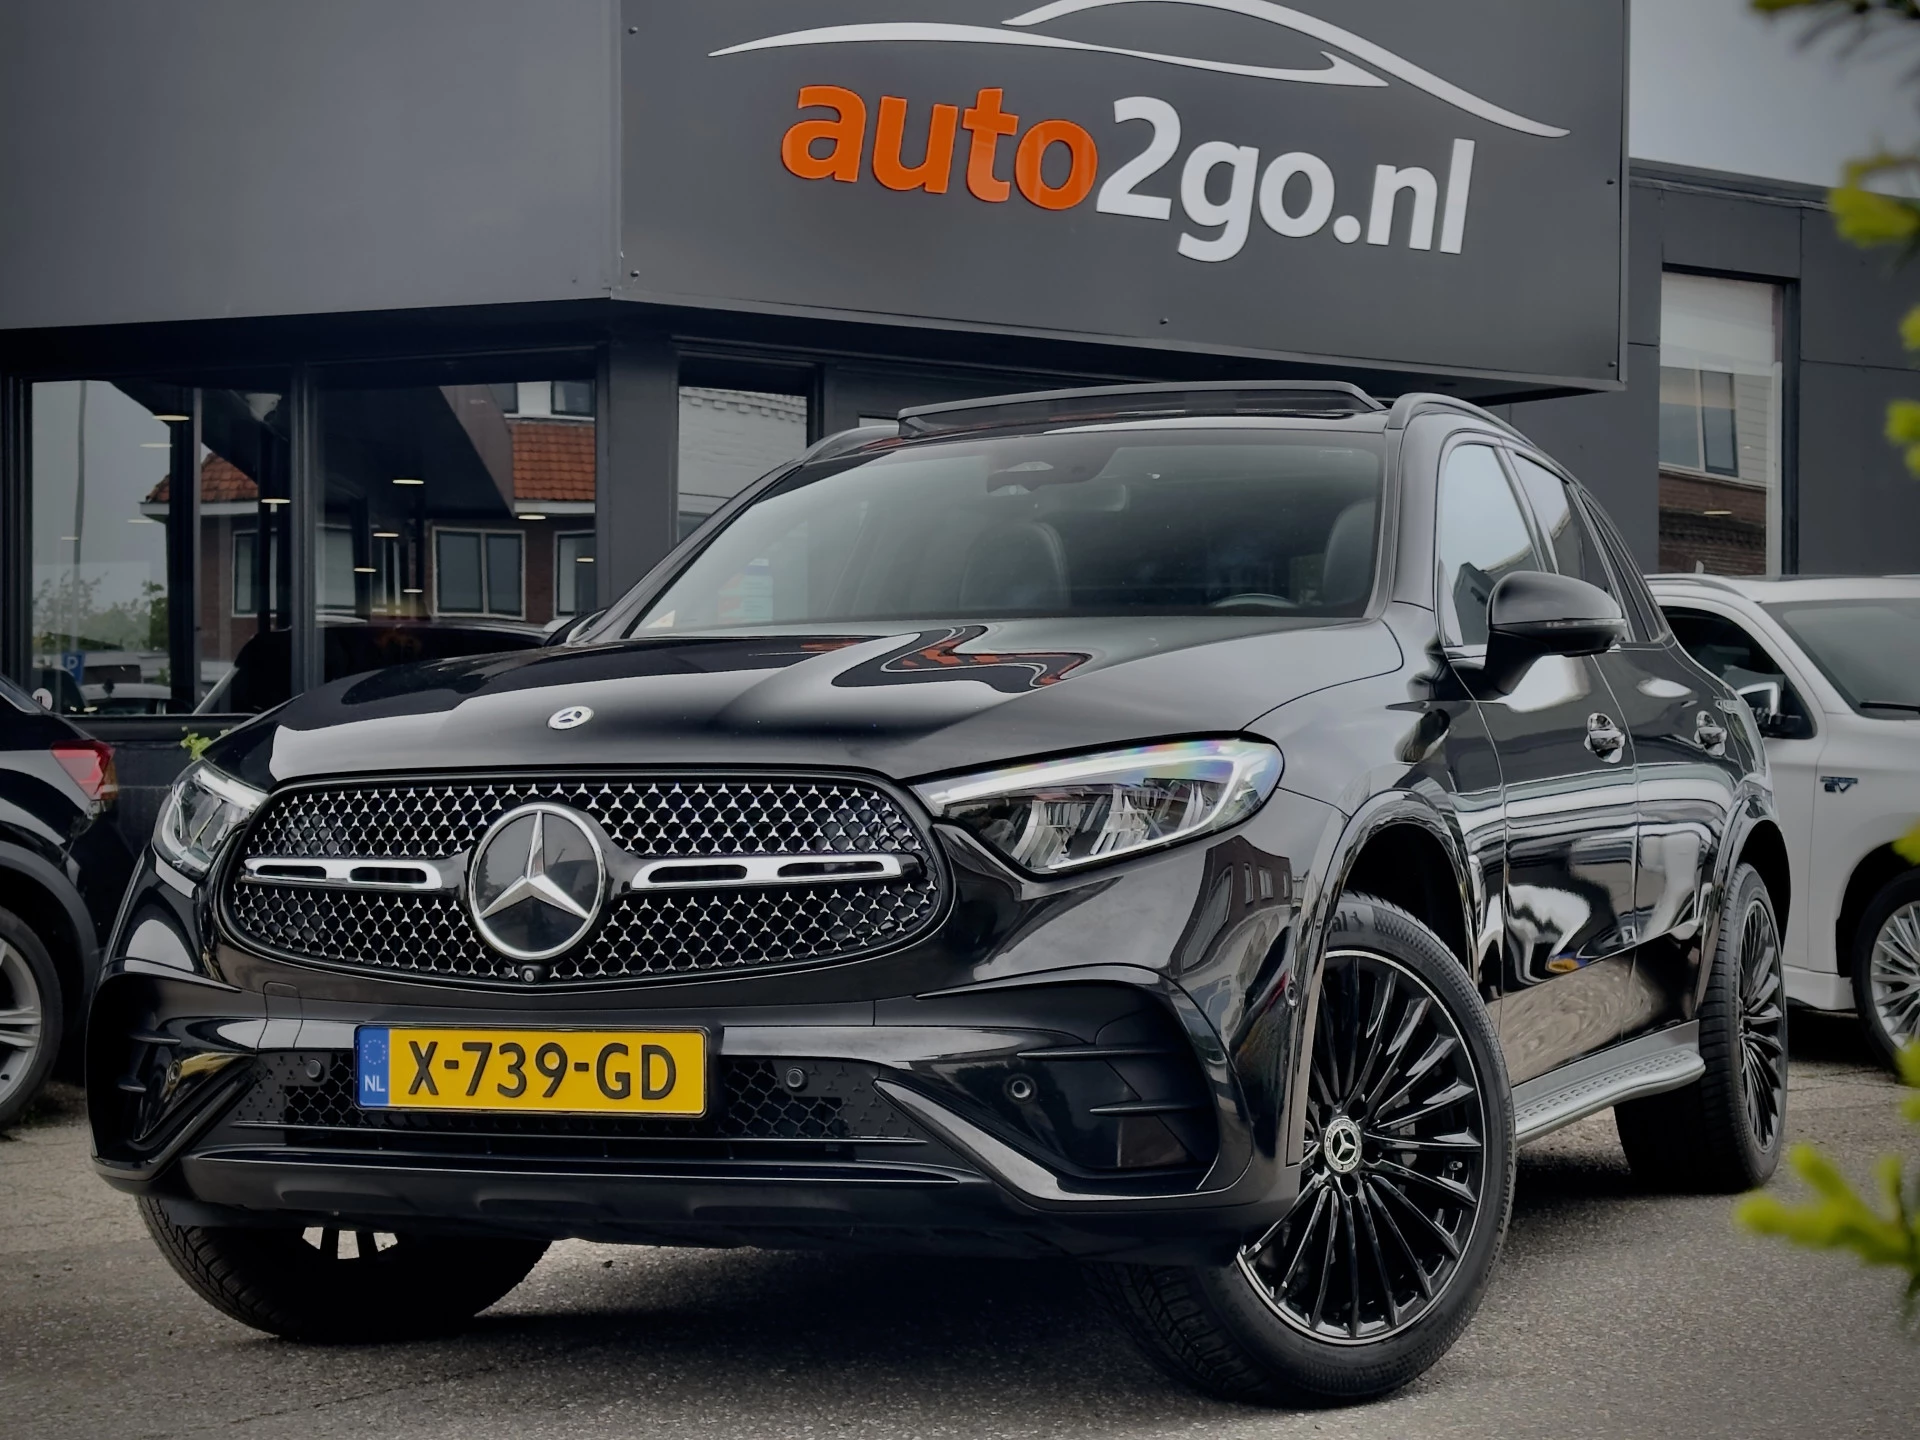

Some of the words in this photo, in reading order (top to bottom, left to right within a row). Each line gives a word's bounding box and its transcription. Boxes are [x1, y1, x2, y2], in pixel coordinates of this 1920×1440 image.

[781, 84, 1475, 262] auto2go.nl
[66, 656, 79, 672] P
[364, 1075, 386, 1092] NL
[408, 1040, 677, 1100] X-739-GD
[1498, 1096, 1514, 1234] WinterContact
